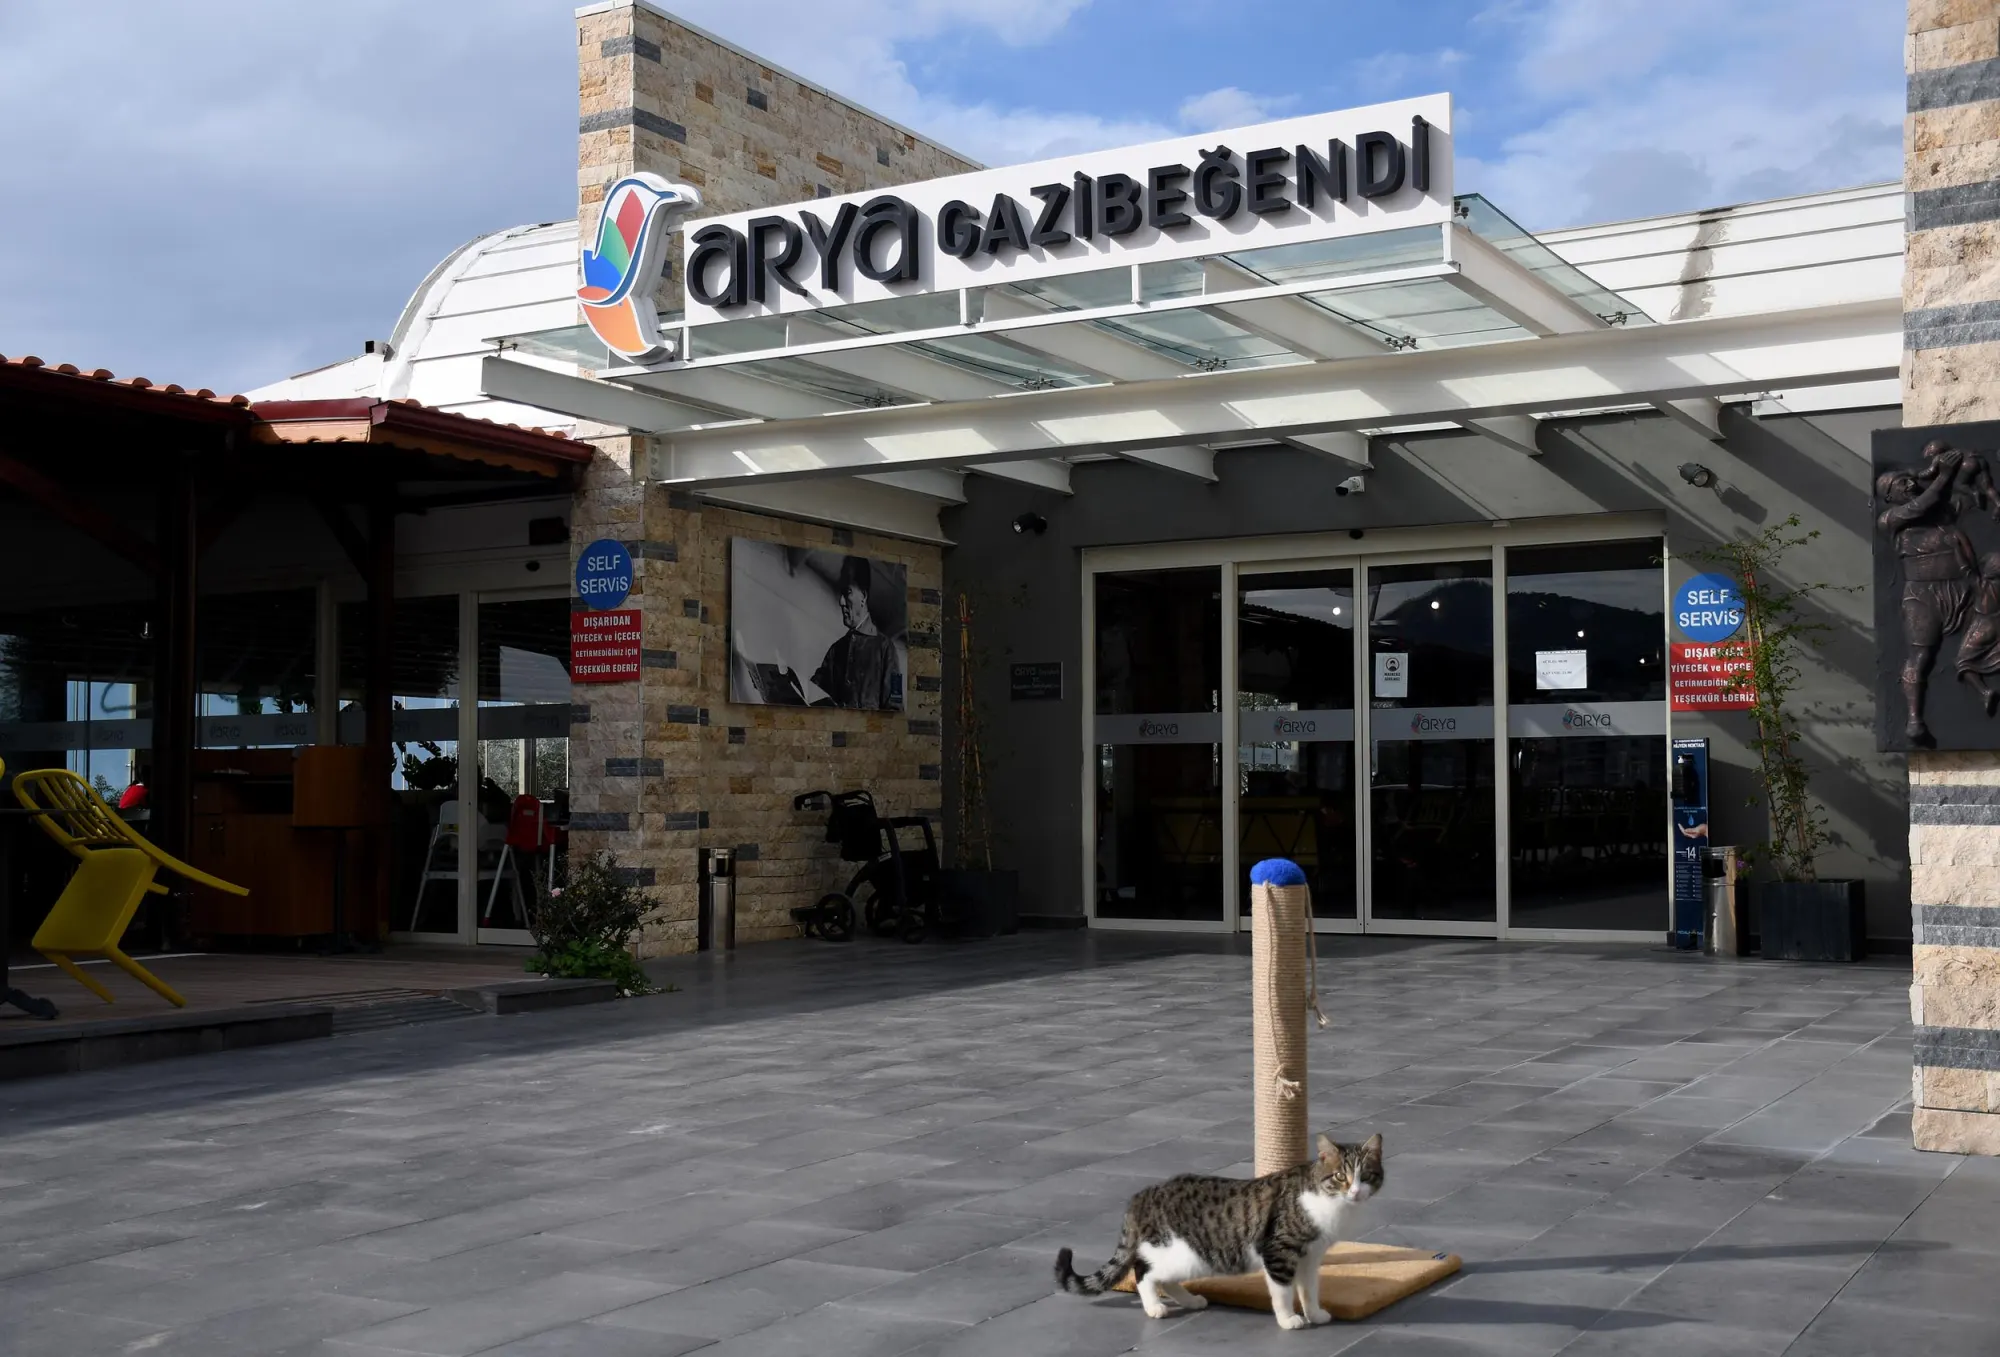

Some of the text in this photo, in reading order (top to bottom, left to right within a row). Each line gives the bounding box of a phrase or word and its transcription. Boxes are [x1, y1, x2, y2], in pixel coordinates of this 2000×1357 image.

[937, 113, 1430, 260] GAZİBEĞENDİ
[587, 554, 621, 572] SELF
[1687, 589, 1730, 606] SELF
[583, 615, 631, 630] DIŞARIDAN
[572, 631, 641, 643] YİYECEK ve İÇECEK
[575, 662, 638, 676] TEŞEKKÜR EDERİZ
[1671, 662, 1754, 673] YİYECEK ve İÇECE
[1674, 693, 1720, 706] TEŞEKKÜR
[1685, 846, 1697, 859] 14
